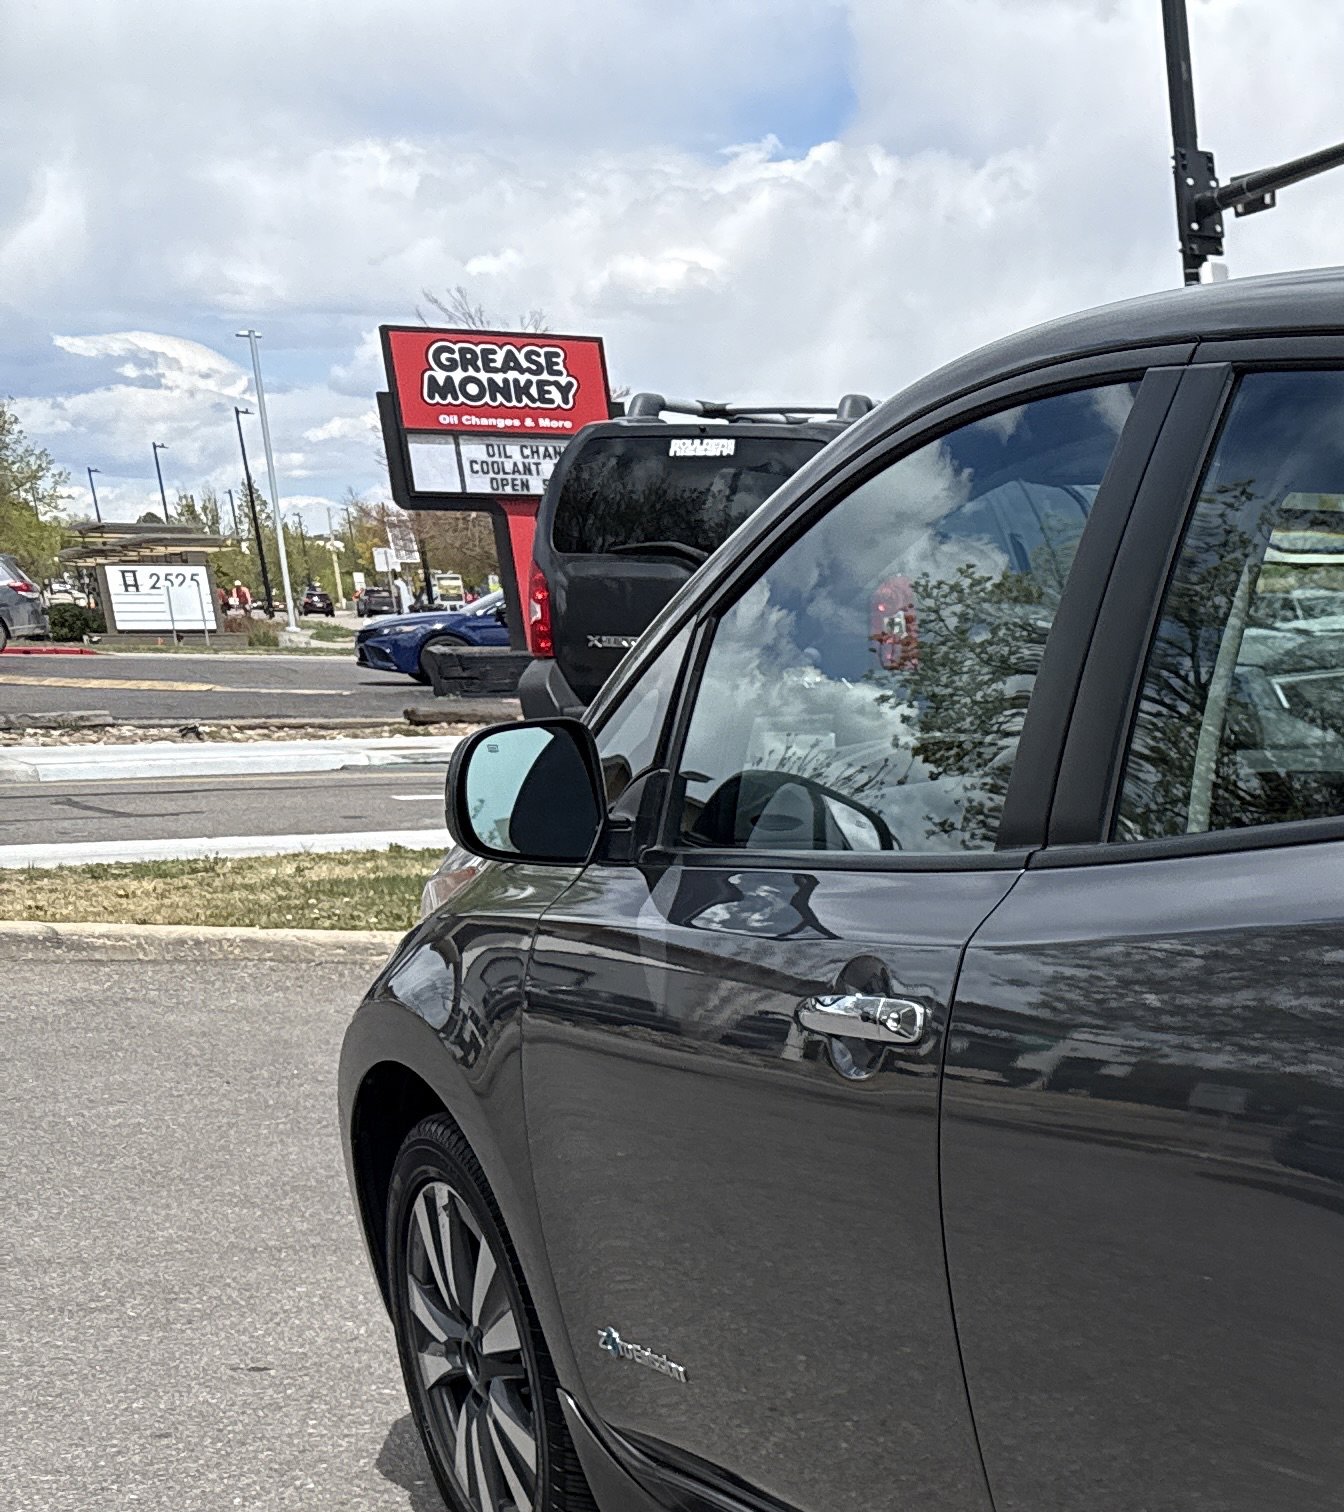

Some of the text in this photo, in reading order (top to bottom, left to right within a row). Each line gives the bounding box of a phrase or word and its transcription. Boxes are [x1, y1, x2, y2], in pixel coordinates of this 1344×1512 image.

[431, 344, 564, 377] GREASE
[426, 373, 575, 406] MONKEY
[439, 414, 573, 429] Oil Changes & More
[485, 443, 513, 459] OIL
[469, 460, 542, 477] COOLANT
[490, 477, 530, 492] OPEN
